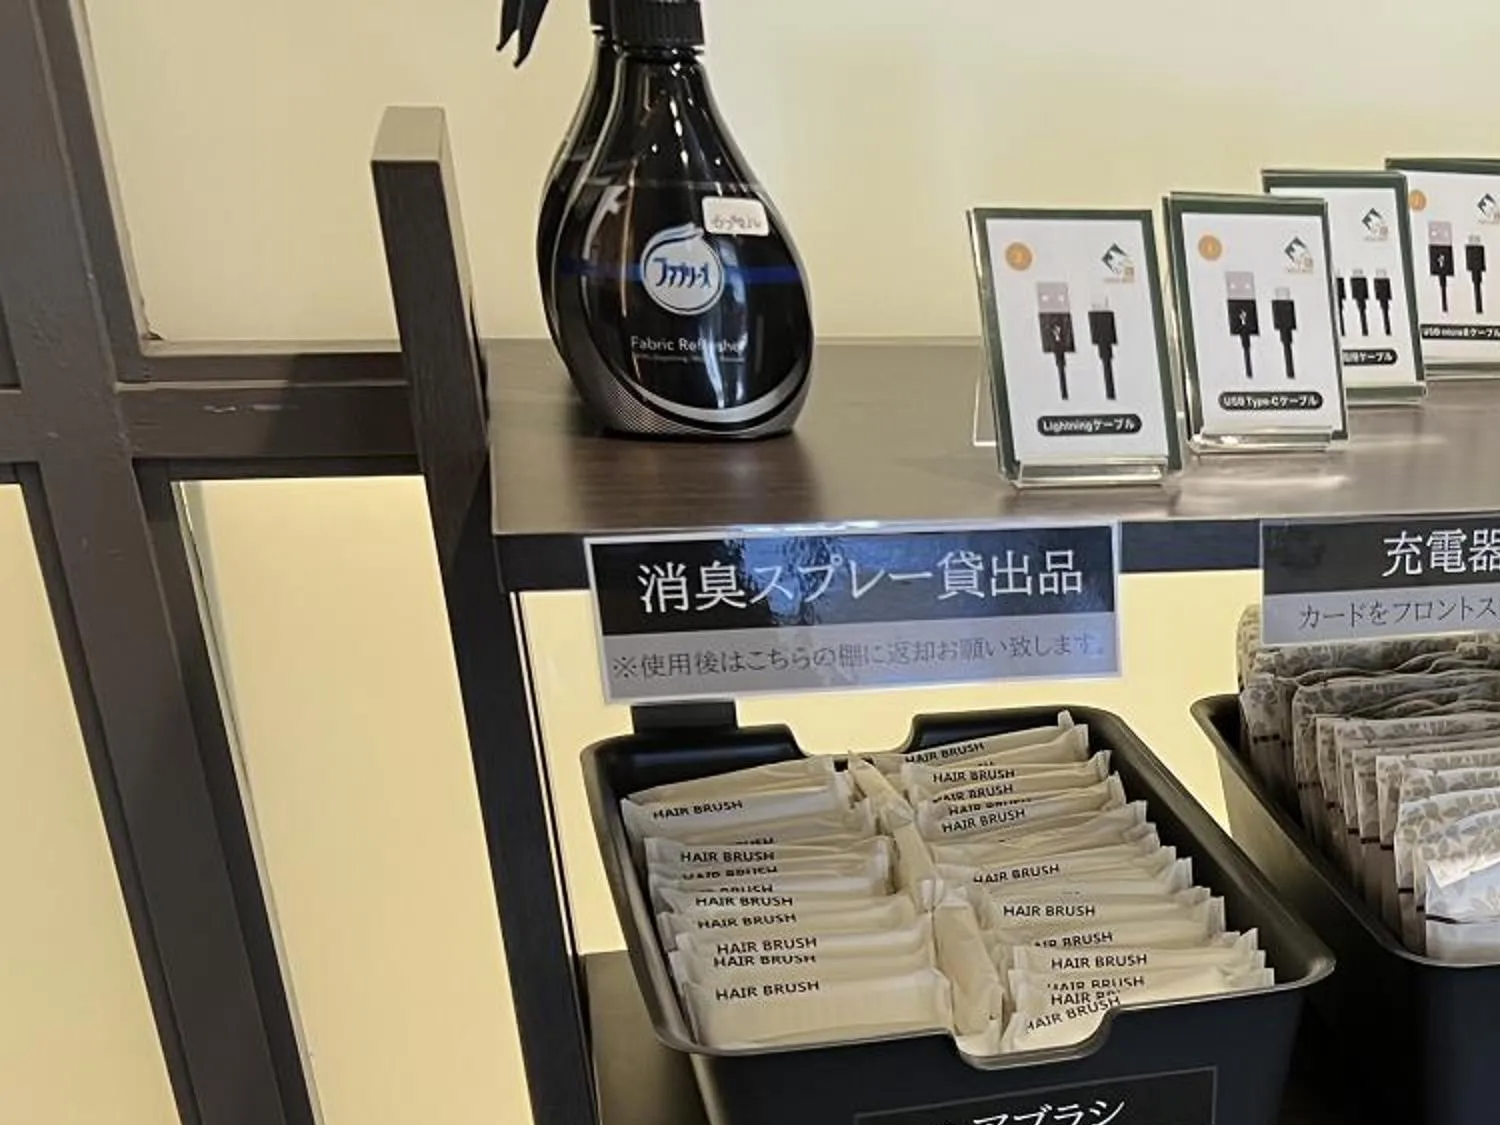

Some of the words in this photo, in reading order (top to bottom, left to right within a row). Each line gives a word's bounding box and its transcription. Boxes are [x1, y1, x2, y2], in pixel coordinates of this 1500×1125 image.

[630, 336, 675, 351] Fabric
[636, 548, 1084, 614] 消臭スプレー貸出品
[941, 742, 985, 758] BRUSH
[933, 771, 966, 783] HAIR
[970, 769, 1015, 781] BRUSH
[968, 784, 1013, 800] BRUSH
[652, 805, 690, 819] HAIR
[693, 799, 744, 814] BRUSH
[942, 818, 977, 833] HAIR
[980, 809, 1026, 827] BRUSH
[680, 851, 719, 863] HAIR
[723, 851, 775, 863] BRUSH
[1012, 863, 1060, 879] BRUSH
[695, 896, 736, 907] HAIR
[739, 896, 793, 907] BRUSH
[1003, 905, 1041, 916] HAIR
[1045, 905, 1096, 917] BRUSH
[697, 918, 738, 929] HAIR
[742, 913, 798, 926] BRUSH
[717, 941, 758, 955] HAIR
[763, 937, 817, 952] BRUSH
[713, 955, 755, 968] HAIR
[760, 954, 817, 966] BRUSH
[1051, 957, 1091, 969] HAIR
[1095, 953, 1148, 968] BRUSH
[715, 987, 758, 1002] HAIR
[763, 981, 820, 997] BRUSH
[1051, 991, 1091, 1006] HAIR
[1066, 996, 1121, 1019] BRUSH
